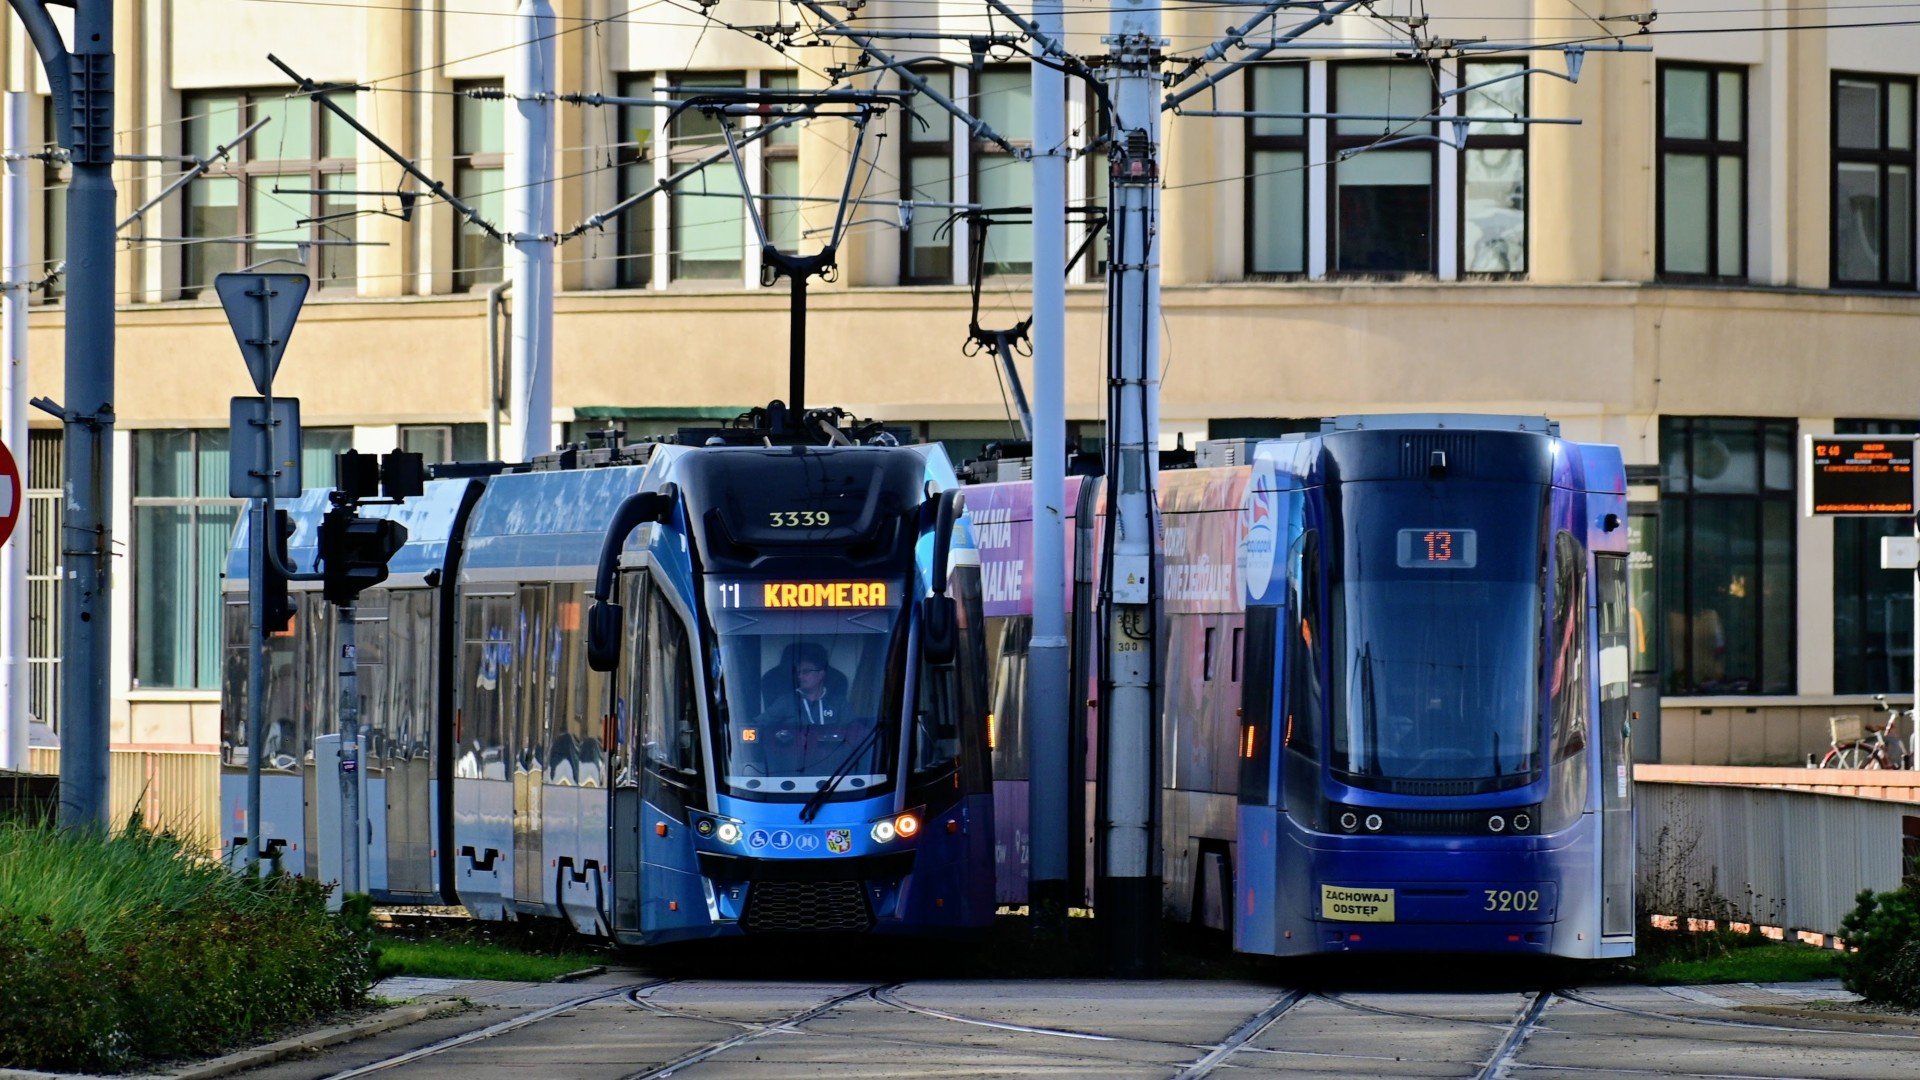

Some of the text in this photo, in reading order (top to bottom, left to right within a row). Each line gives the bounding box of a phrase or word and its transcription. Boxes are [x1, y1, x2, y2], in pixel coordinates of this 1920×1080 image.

[769, 511, 830, 527] 3339
[1424, 531, 1451, 560] 13
[719, 582, 886, 608] 11 KROMERA
[1118, 642, 1138, 652] 300
[1325, 890, 1388, 903] ZACHOWAJ
[1483, 890, 1539, 911] 3202
[1333, 903, 1378, 917] ODSTĘP
